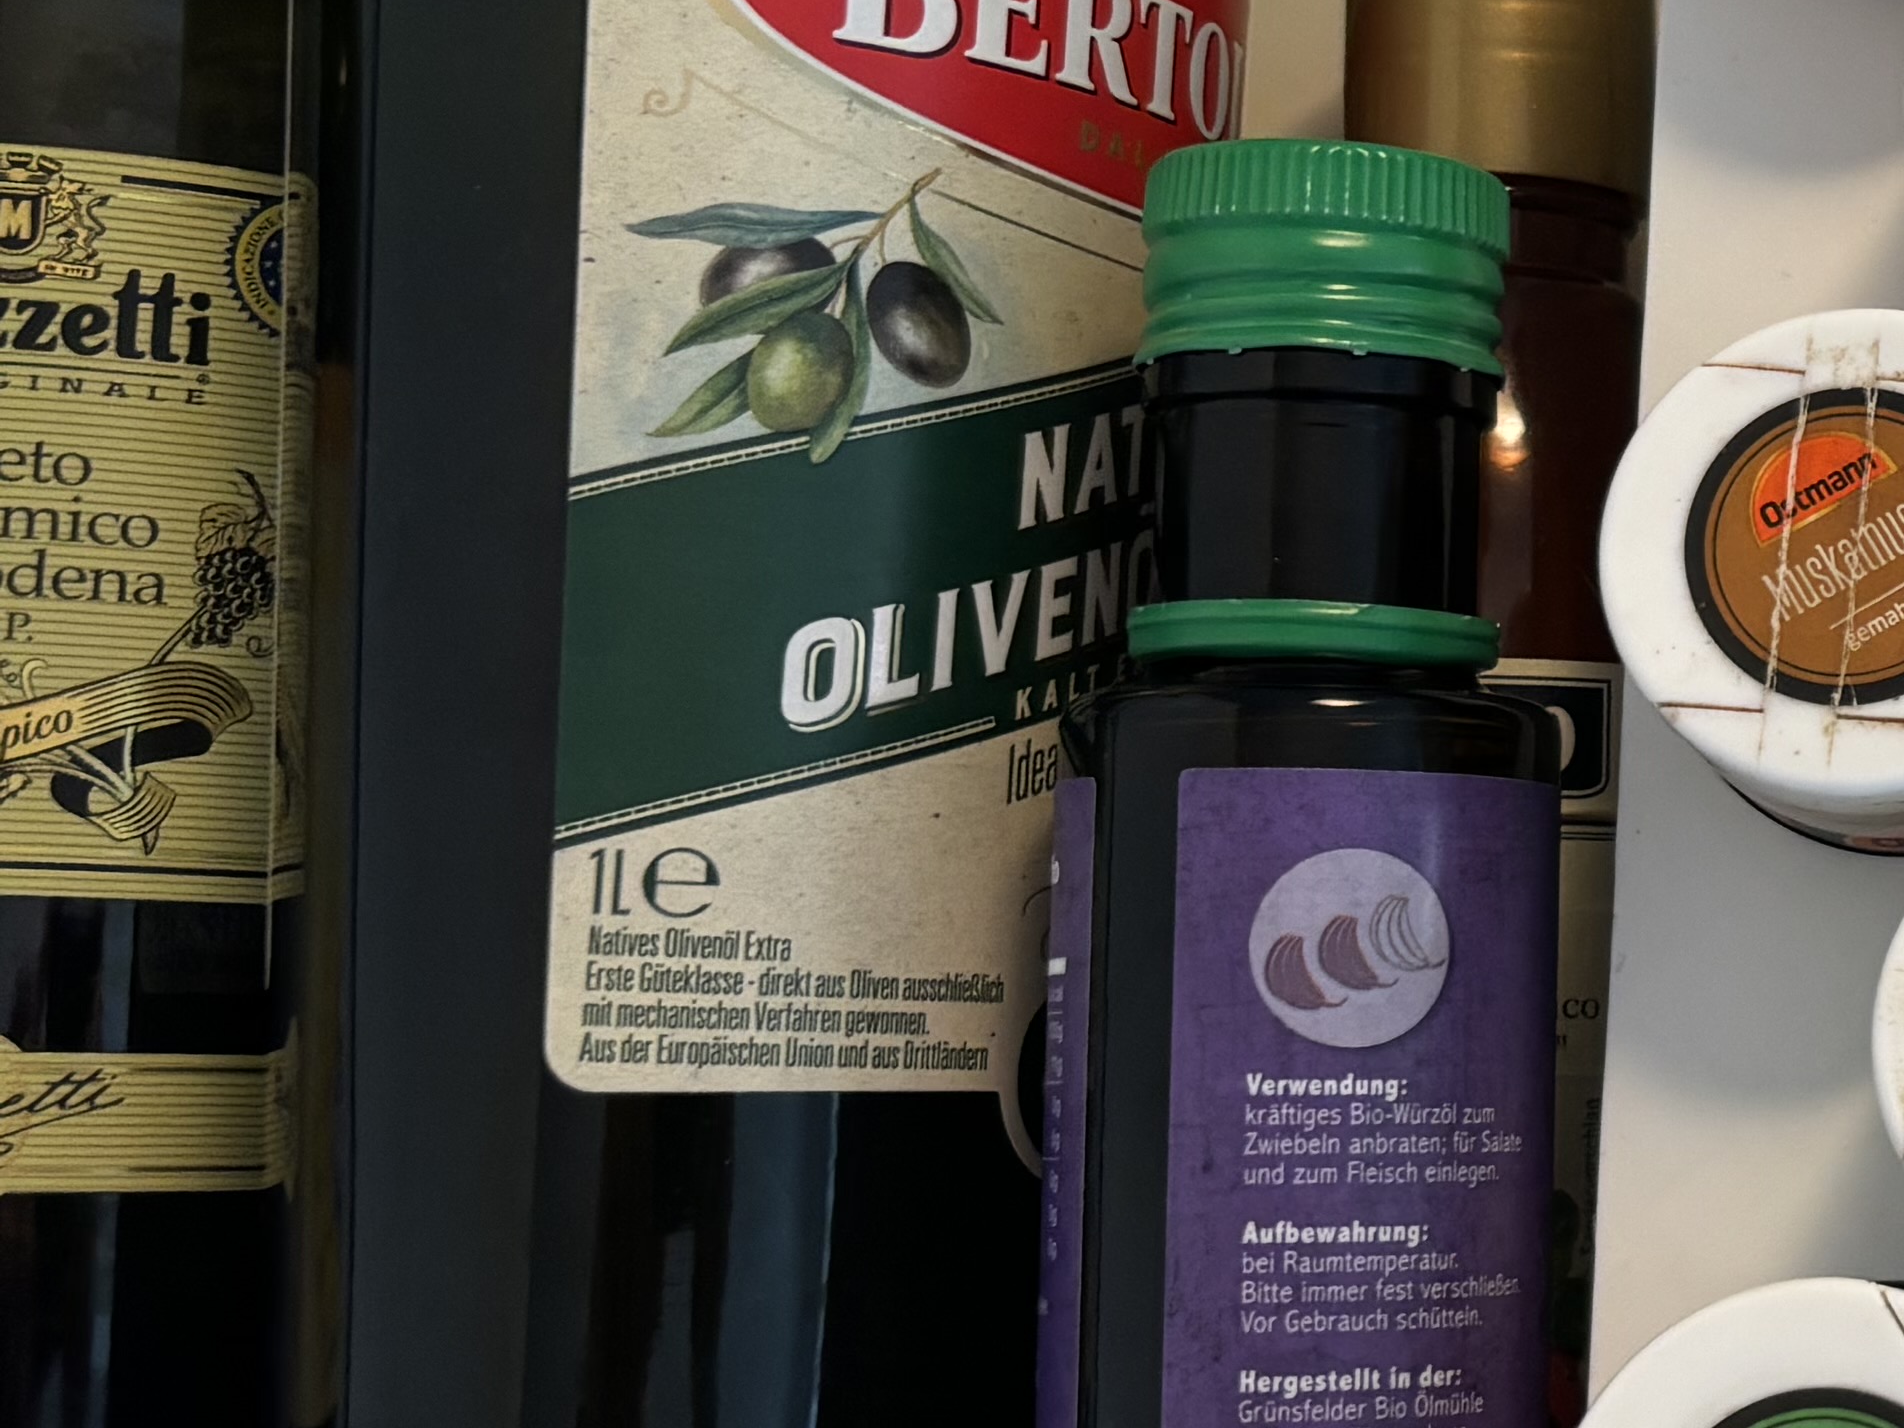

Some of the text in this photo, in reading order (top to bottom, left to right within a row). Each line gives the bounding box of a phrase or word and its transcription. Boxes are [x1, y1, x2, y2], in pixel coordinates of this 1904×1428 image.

[1759, 452, 1878, 528] Ostmann
[588, 925, 792, 961] Natives Olivenöl Extra
[585, 961, 636, 991] Erste
[640, 962, 743, 995] Güteklasse
[759, 967, 810, 998] direkt
[815, 977, 845, 999] aus
[850, 969, 899, 1001] Oliven
[582, 998, 930, 1038] mit mechanischen Verfahren gewonnen.
[579, 1033, 988, 1071] Aus der Europäischen Union und aus Drittländern
[1246, 1073, 1408, 1101] Verwendung:
[1245, 1103, 1494, 1131] kräftiges Bio-Würzöl zum
[1244, 1132, 1476, 1155] Zwiebeln anbraten; für
[1244, 1161, 1499, 1188] und zum Fleisch einlegen.
[1242, 1221, 1429, 1247] Aufbewahrung:
[1284, 1251, 1458, 1276] Raumtemperatur.
[1241, 1278, 1413, 1303] Bitte immer fest
[1241, 1309, 1388, 1333] Vor Gebrauch
[1239, 1364, 1462, 1398] Hergestellt der:
[1238, 1390, 1483, 1423] Grünsfelder Bio Ölmühle
